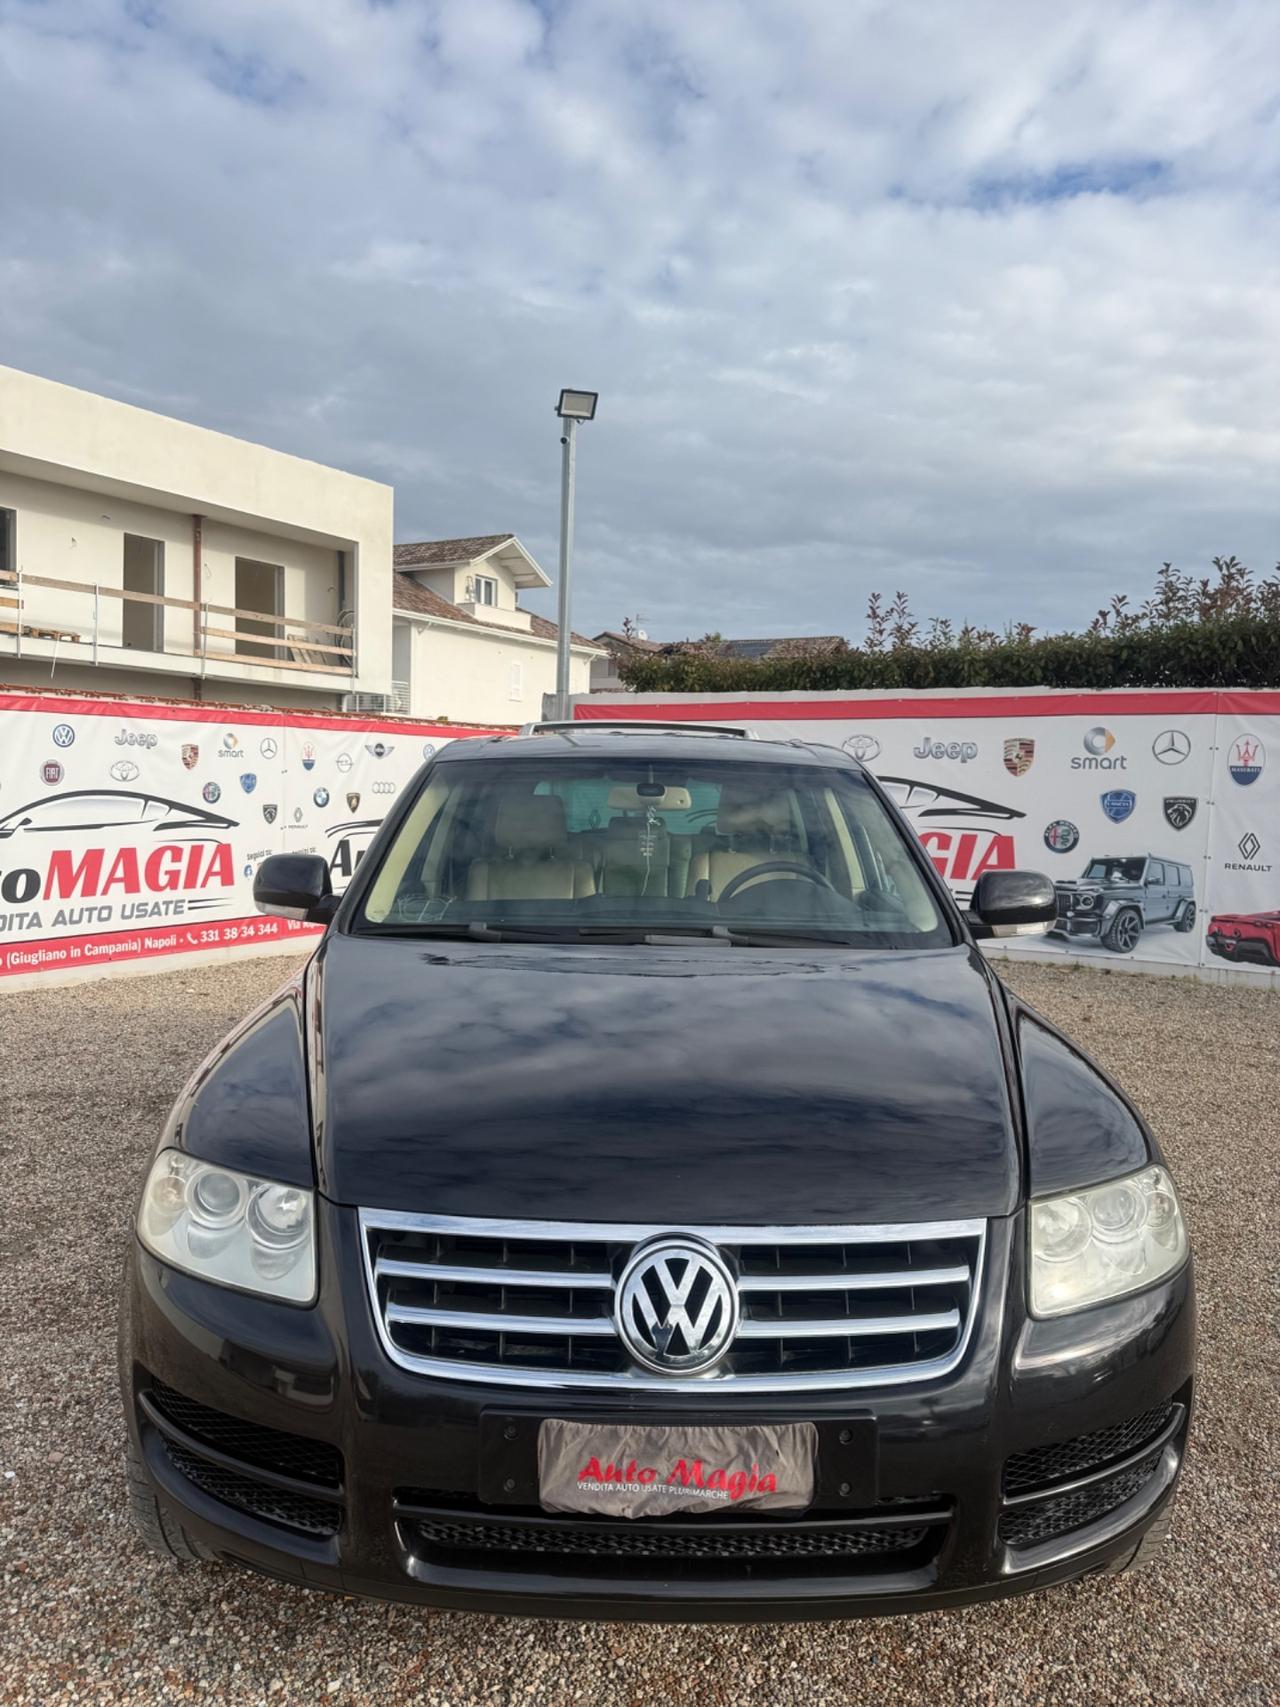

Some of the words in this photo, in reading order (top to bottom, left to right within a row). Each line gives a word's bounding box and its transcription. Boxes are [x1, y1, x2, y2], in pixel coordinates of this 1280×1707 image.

[114, 729, 158, 749] Jeep
[218, 749, 244, 758] smart
[913, 737, 978, 763] Jeep
[1071, 755, 1127, 770] smart
[45, 767, 60, 779] FIAT
[0, 843, 235, 904] oMAGIA
[1224, 863, 1272, 872] RENAULT
[51, 905, 113, 927] AUTO
[121, 899, 186, 920] USATE
[6, 949, 67, 969] (Giugliano
[70, 946, 81, 958] in
[84, 939, 141, 958] Campania)
[144, 936, 176, 950] Napoli
[200, 929, 220, 943] 331
[224, 927, 238, 940] 38
[241, 925, 255, 938] 34
[257, 922, 278, 935] 344
[578, 1456, 656, 1484] Auto
[667, 1457, 777, 1500] Magia
[577, 1481, 614, 1492] VENDITA
[616, 1482, 640, 1493] AUTO
[641, 1484, 667, 1494] USATE
[669, 1485, 729, 1500] PLURIMARCHE
